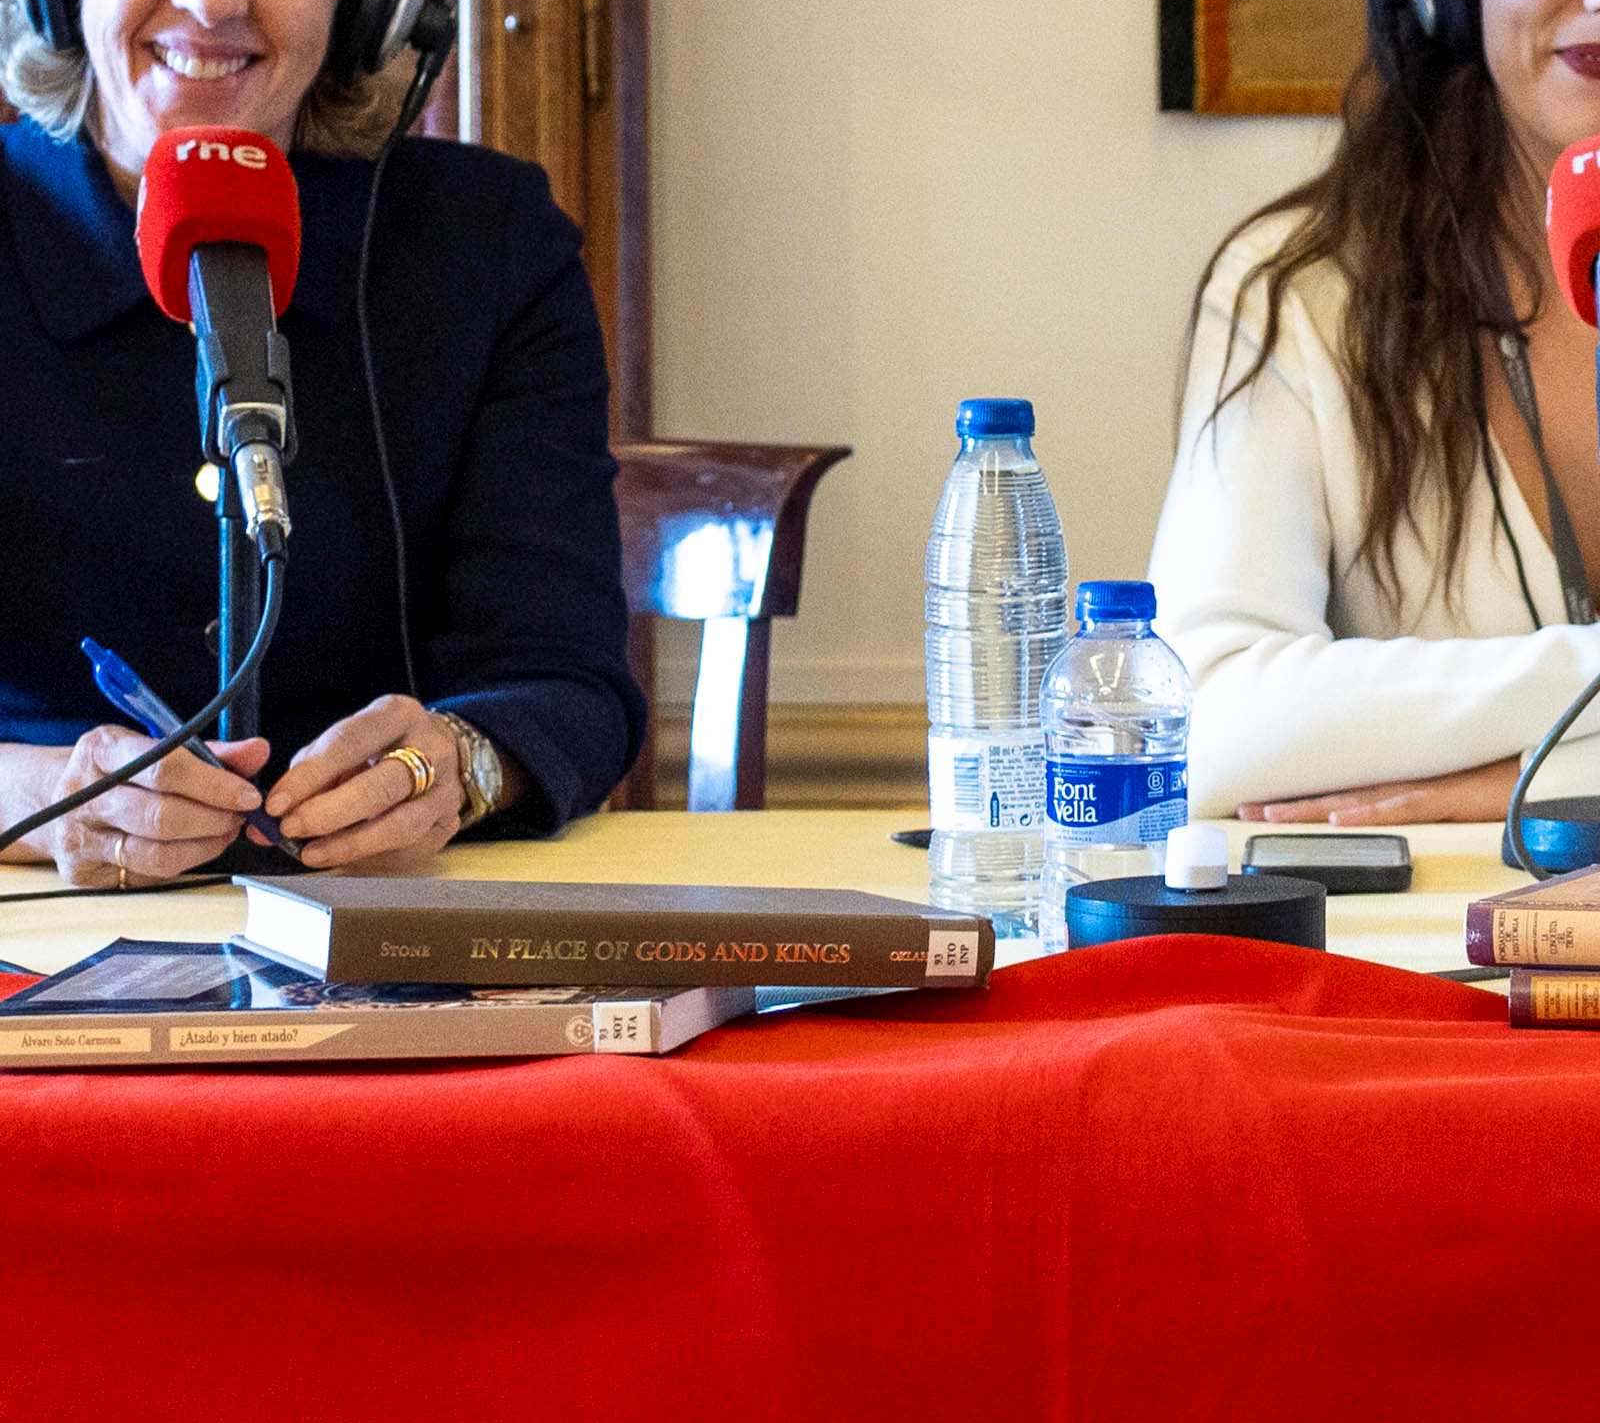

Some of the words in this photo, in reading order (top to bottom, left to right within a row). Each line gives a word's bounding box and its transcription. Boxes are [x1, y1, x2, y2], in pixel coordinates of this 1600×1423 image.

[175, 138, 267, 169] rne
[1053, 777, 1098, 800] Font
[1053, 800, 1099, 823] Vella
[469, 938, 502, 960] IN
[506, 938, 589, 961] PLACE
[593, 940, 630, 962] OF
[634, 940, 707, 962] GODS
[711, 942, 770, 964] AND
[774, 942, 851, 965] KINGS
[946, 941, 957, 967] STO
[20, 1033, 51, 1048] Álvaro
[180, 1030, 219, 1047] ¿Atado
[221, 1033, 230, 1046] y
[232, 1029, 258, 1043] bien
[260, 1028, 299, 1043] atado?
[612, 1015, 625, 1041] SOT
[626, 1014, 639, 1042] ATA
